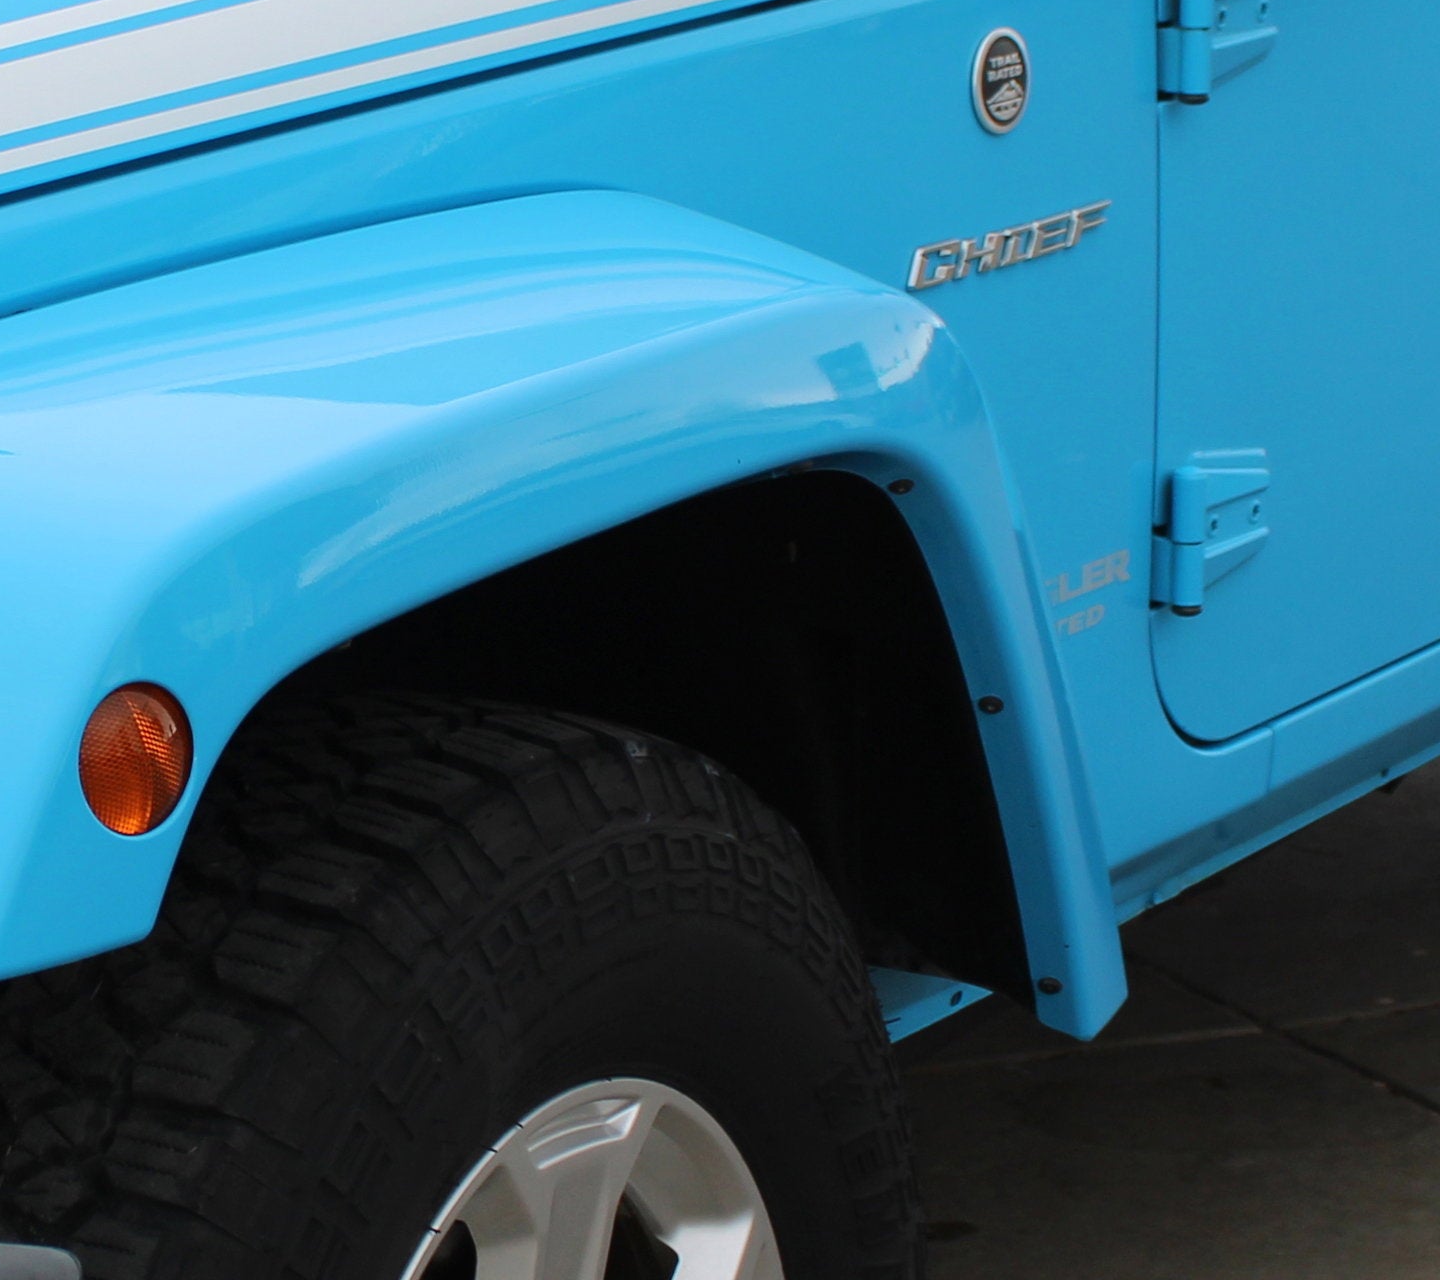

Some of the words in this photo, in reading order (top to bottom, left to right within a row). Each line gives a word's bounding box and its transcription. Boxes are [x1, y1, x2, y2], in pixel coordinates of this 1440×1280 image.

[989, 51, 1022, 69] TRAIL
[987, 64, 1024, 83] RATED
[906, 199, 1113, 291] CHIEF
